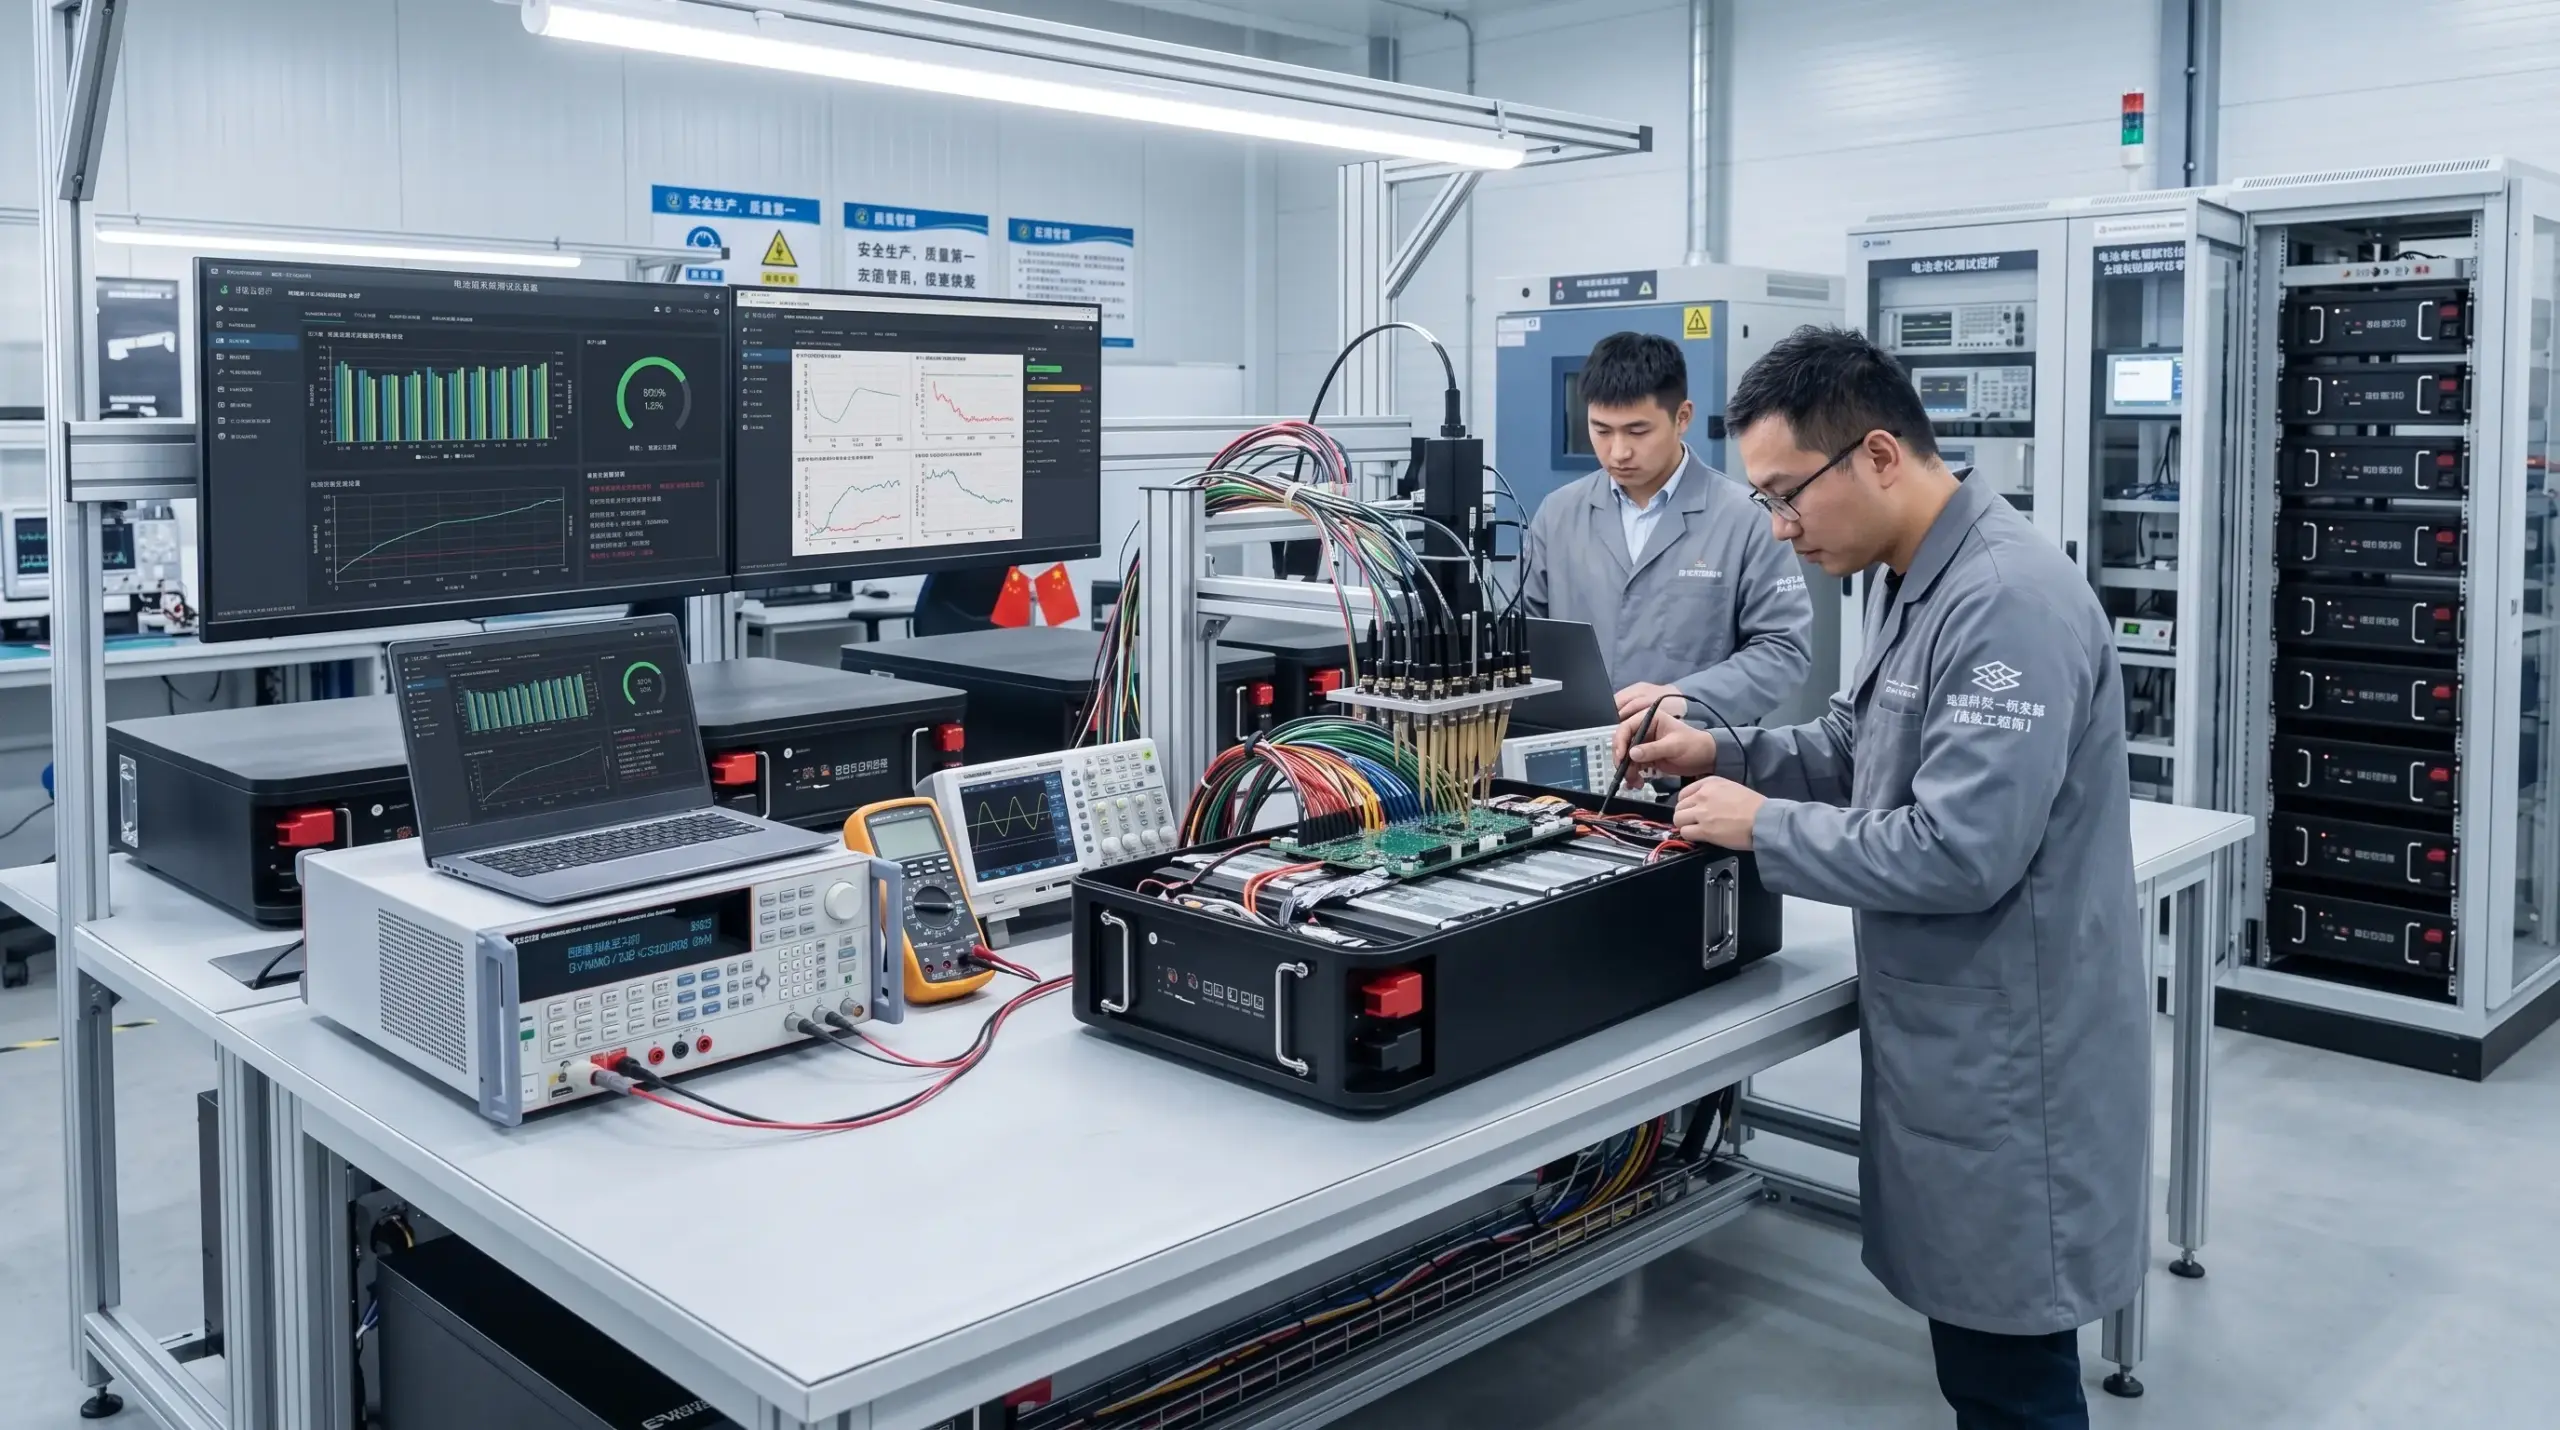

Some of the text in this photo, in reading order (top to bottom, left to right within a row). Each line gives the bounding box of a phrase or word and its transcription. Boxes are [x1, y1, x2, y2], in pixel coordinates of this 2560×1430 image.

[858, 241, 976, 264] 安全生产，质量第一
